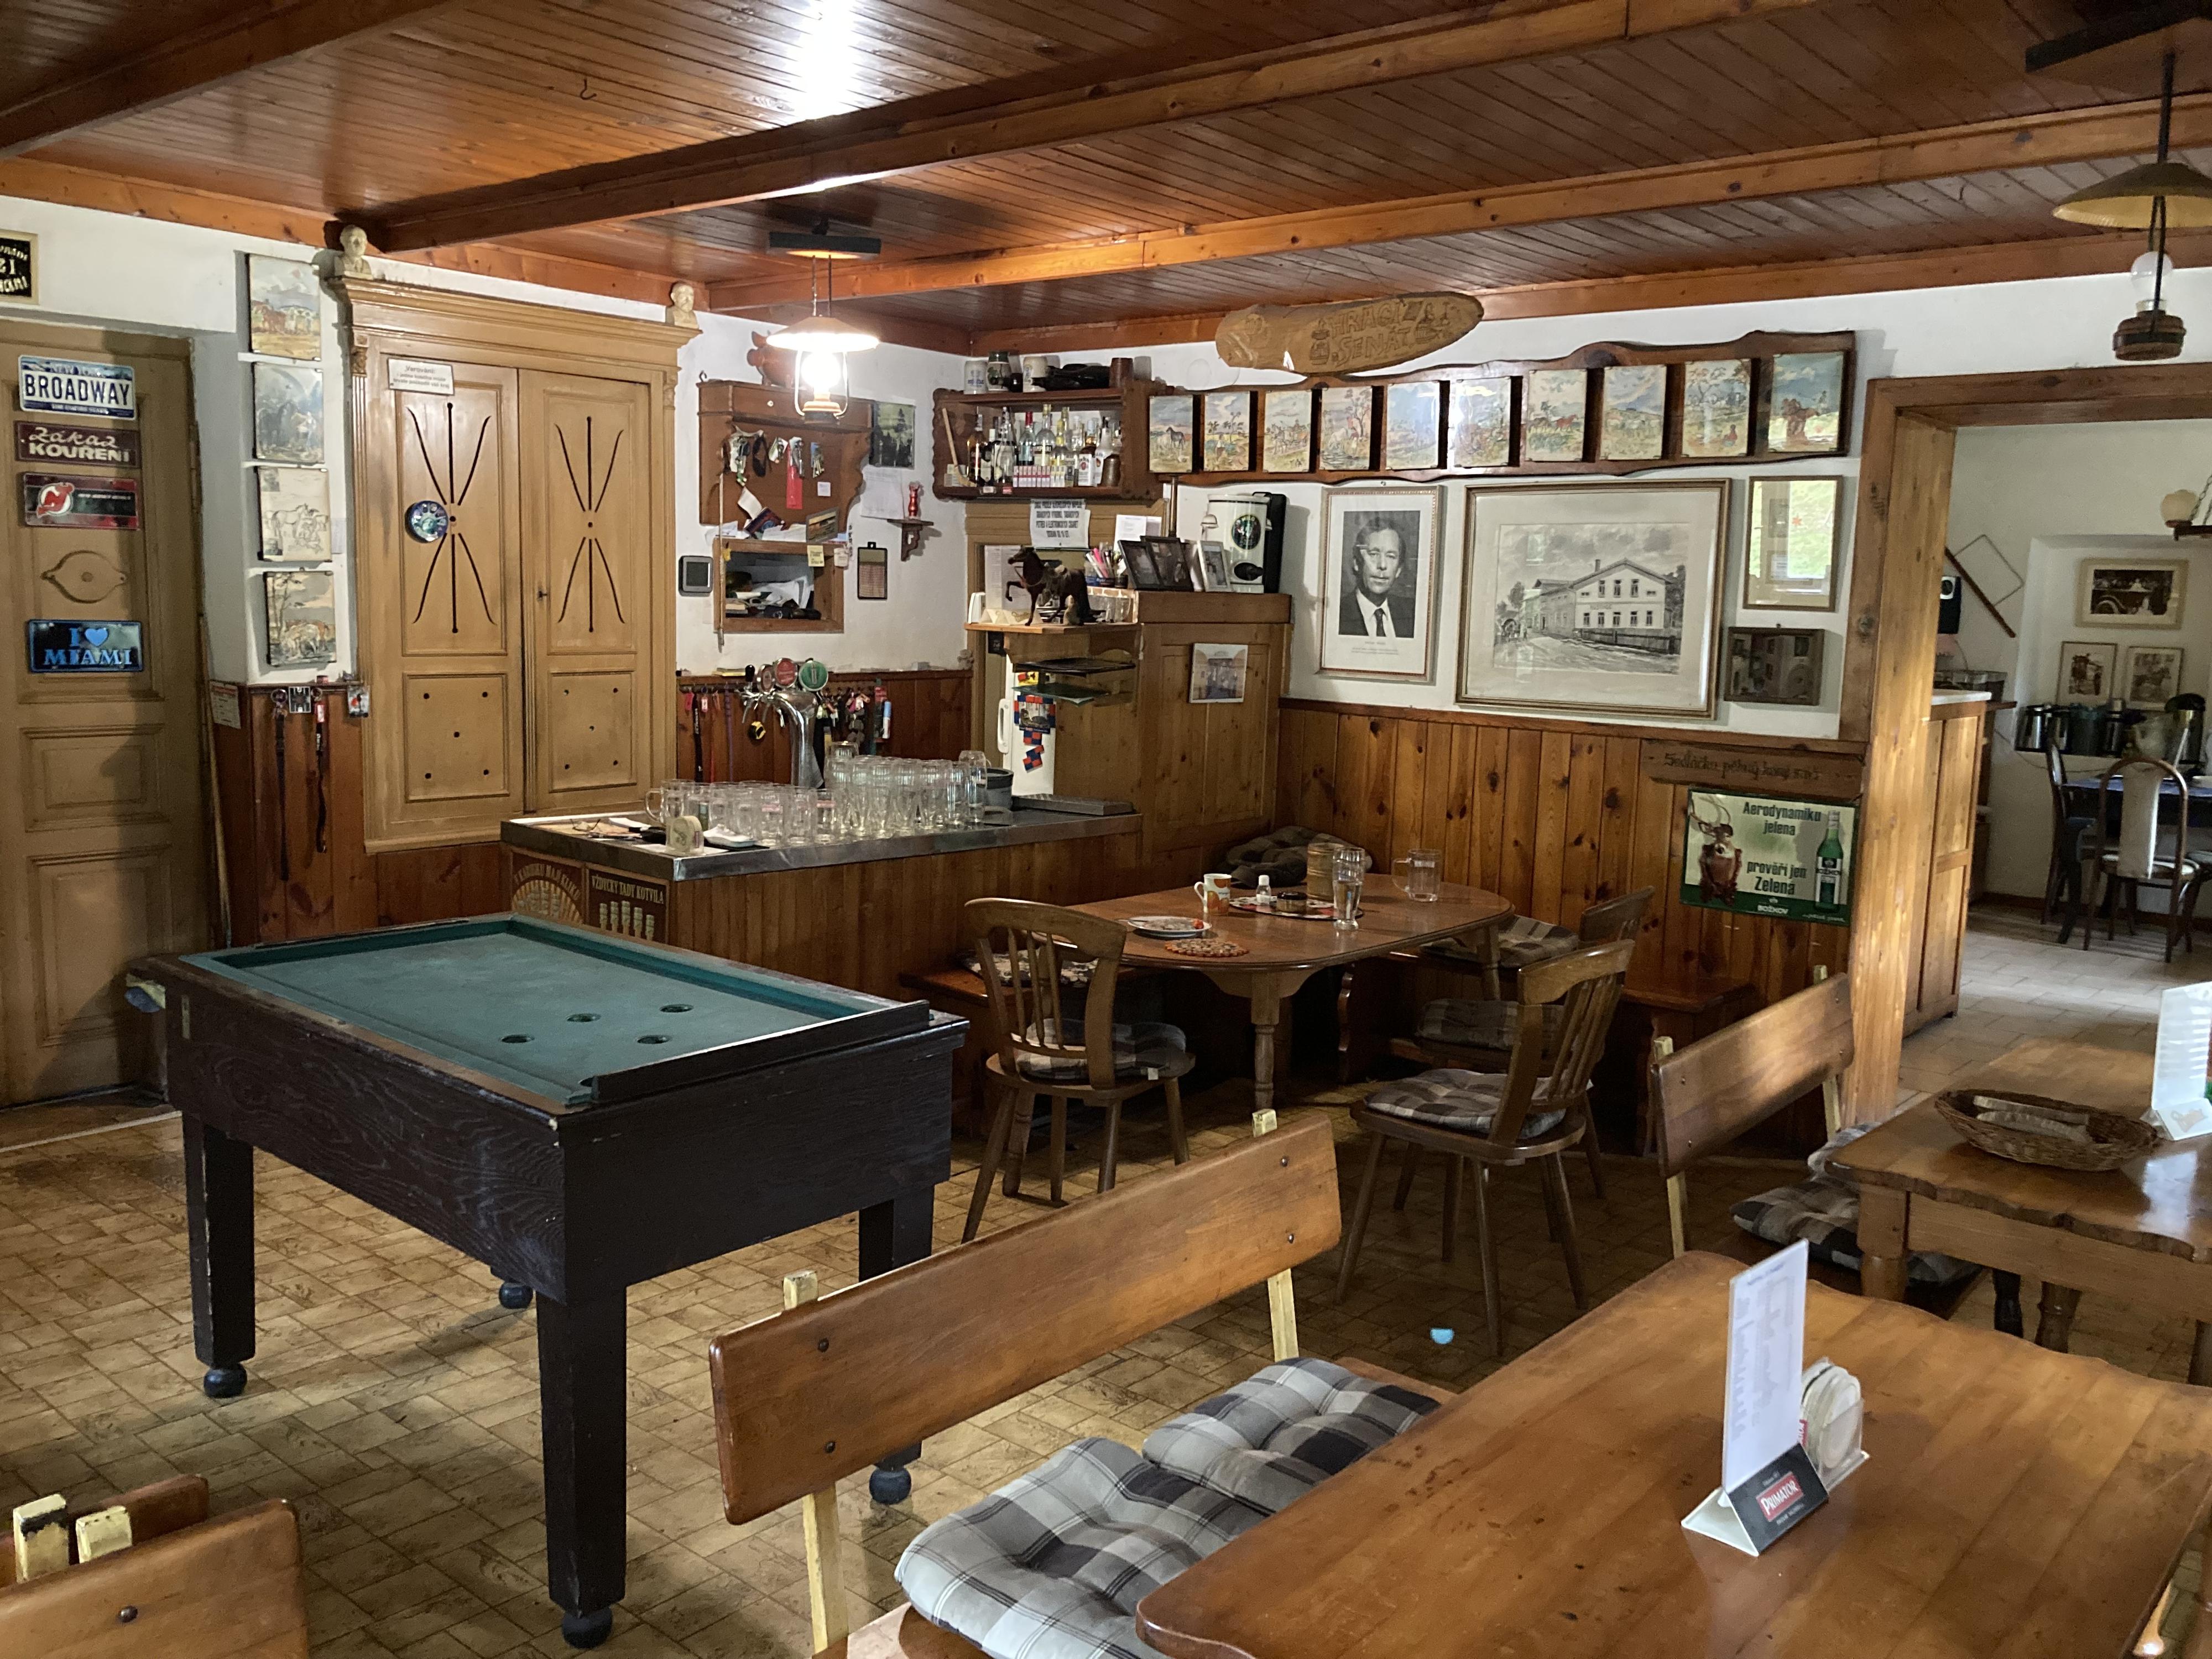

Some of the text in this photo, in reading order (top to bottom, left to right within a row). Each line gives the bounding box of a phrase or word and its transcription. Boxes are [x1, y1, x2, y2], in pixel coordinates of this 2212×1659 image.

[24, 373, 129, 406] BROADWAY
[29, 427, 119, 448] Zákaz
[70, 628, 80, 647] I
[44, 649, 132, 665] MIAMI
[1743, 801, 1822, 822] Aerodynamiku
[1762, 820, 1796, 836] jelena
[1746, 861, 1807, 879] prověří jen
[619, 881, 637, 898] TADY
